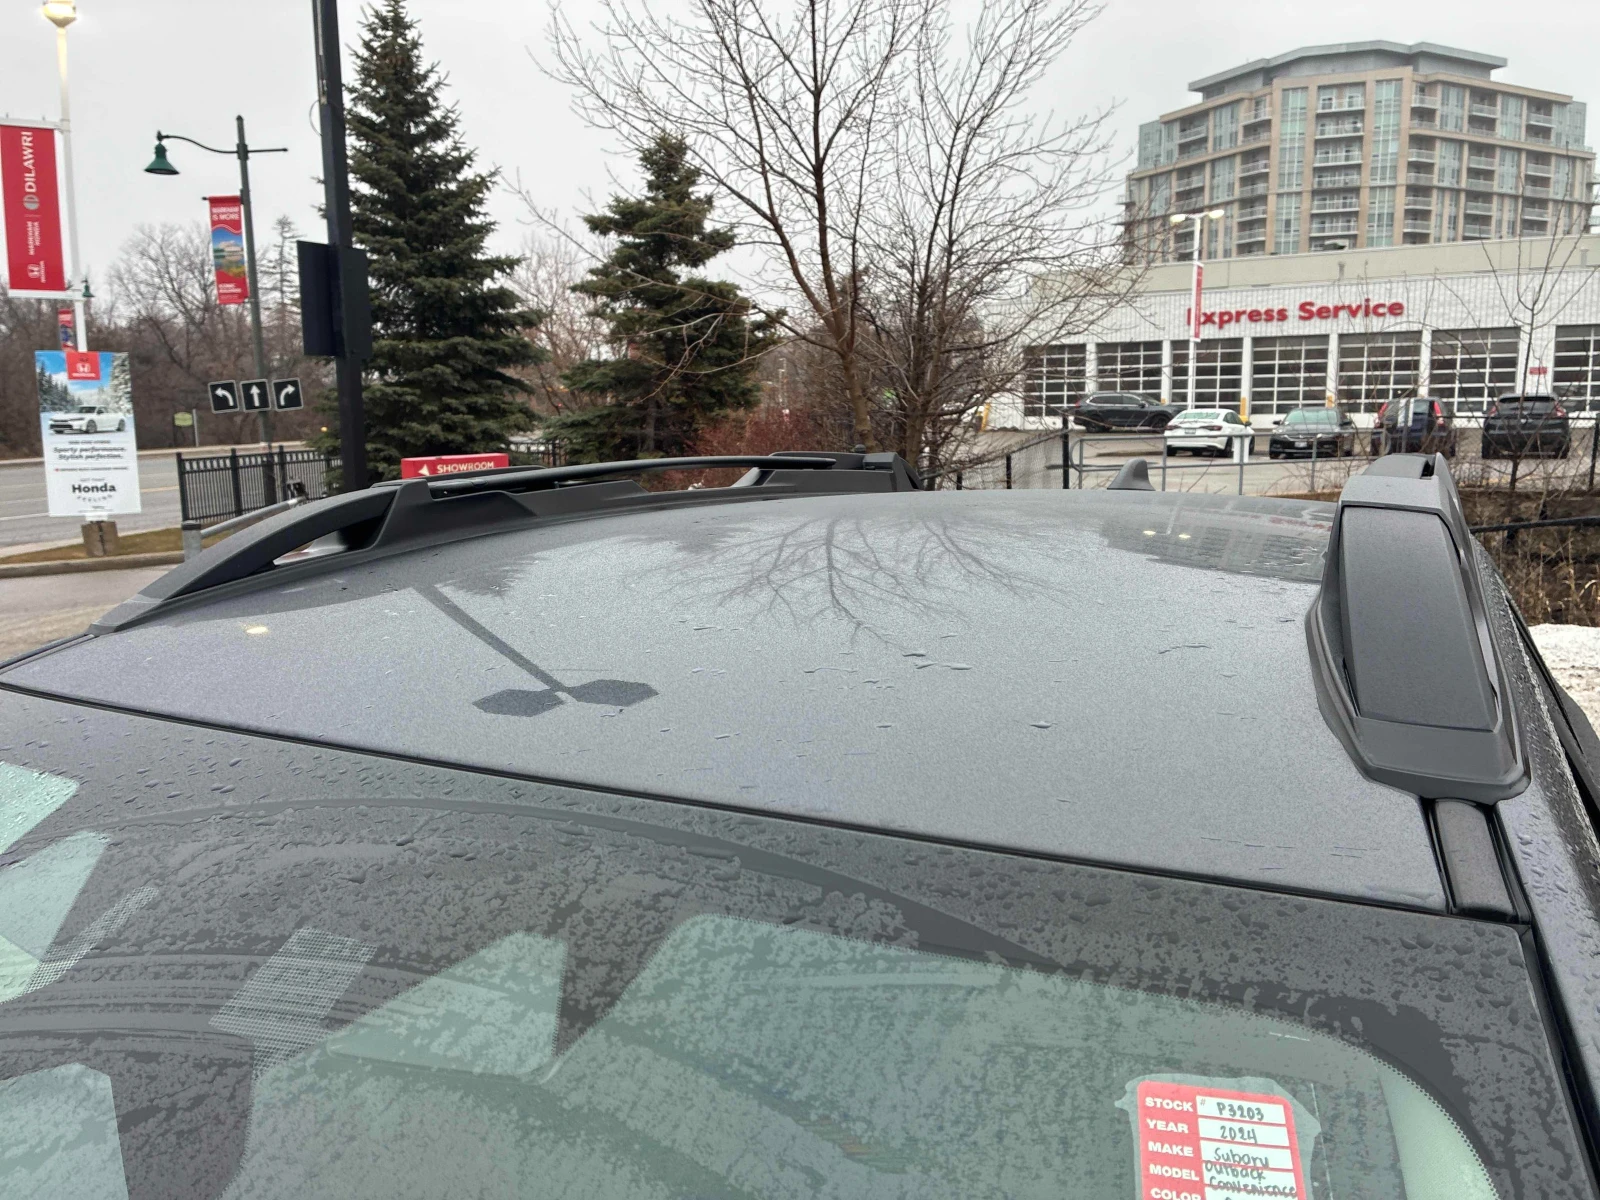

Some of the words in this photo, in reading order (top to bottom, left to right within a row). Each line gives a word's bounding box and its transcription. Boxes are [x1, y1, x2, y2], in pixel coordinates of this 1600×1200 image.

[21, 131, 37, 193] DILAWRI
[1187, 307, 1288, 329] xpress
[1299, 298, 1405, 321] Service
[54, 446, 77, 454] Sporty
[437, 461, 495, 474] SHOWROOM
[72, 483, 116, 493] Honda
[1145, 1097, 1193, 1112] STOCK
[1216, 1102, 1264, 1121] P3203
[1146, 1119, 1188, 1133] YEAR
[1219, 1125, 1257, 1144] 2024
[1148, 1141, 1193, 1157] MAKE
[1214, 1147, 1269, 1169] Subaru
[1149, 1164, 1200, 1181] MODEL
[1151, 1188, 1201, 1200] COLOR
